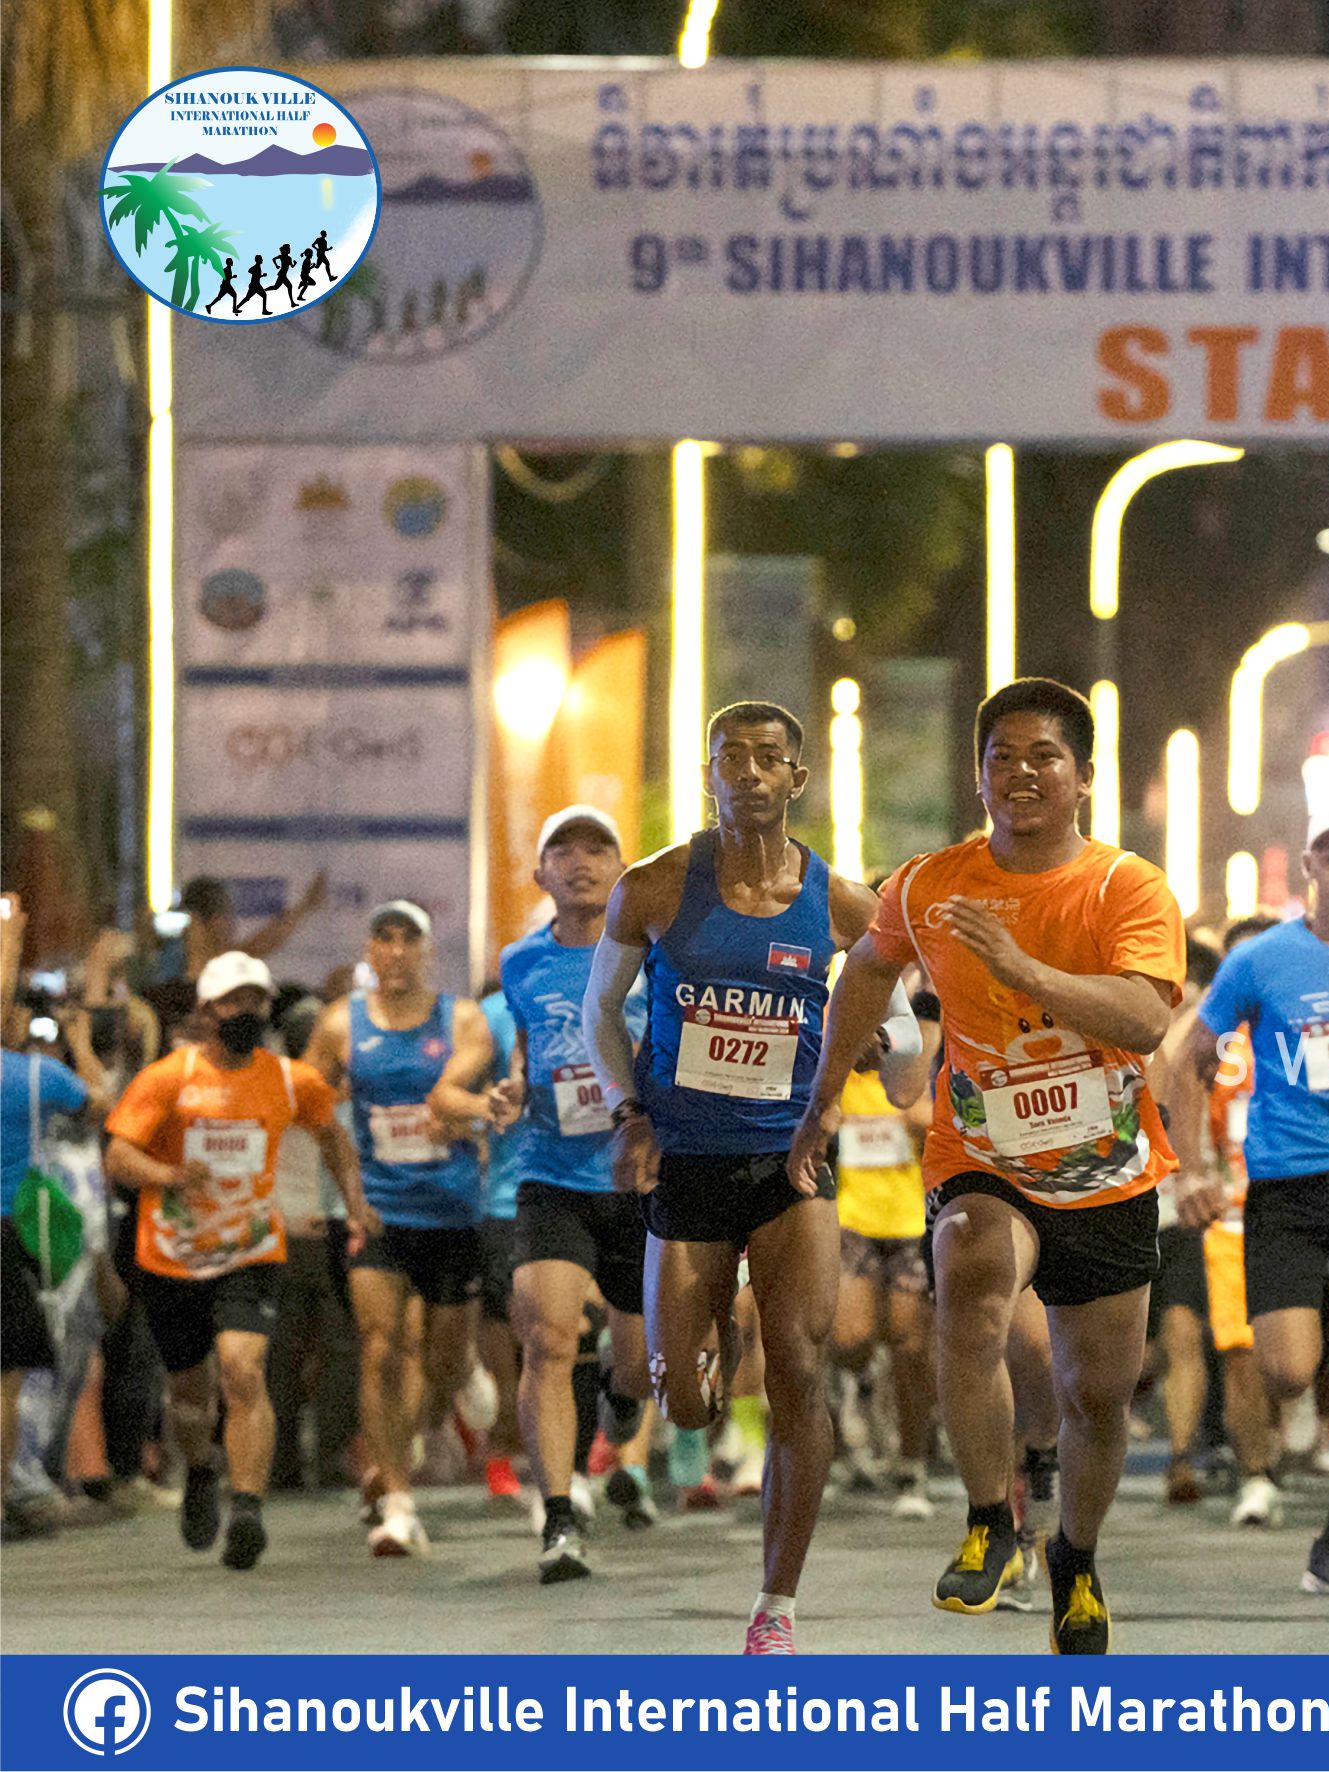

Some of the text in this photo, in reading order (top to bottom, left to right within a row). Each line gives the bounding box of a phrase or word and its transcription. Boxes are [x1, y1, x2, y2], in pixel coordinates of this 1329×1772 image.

[725, 234, 1213, 293] SIHANOUKVILLE
[675, 983, 808, 1024] GARMIN
[708, 1035, 769, 1067] 0272
[576, 1083, 603, 1106] 00
[1013, 1081, 1078, 1120] 0007
